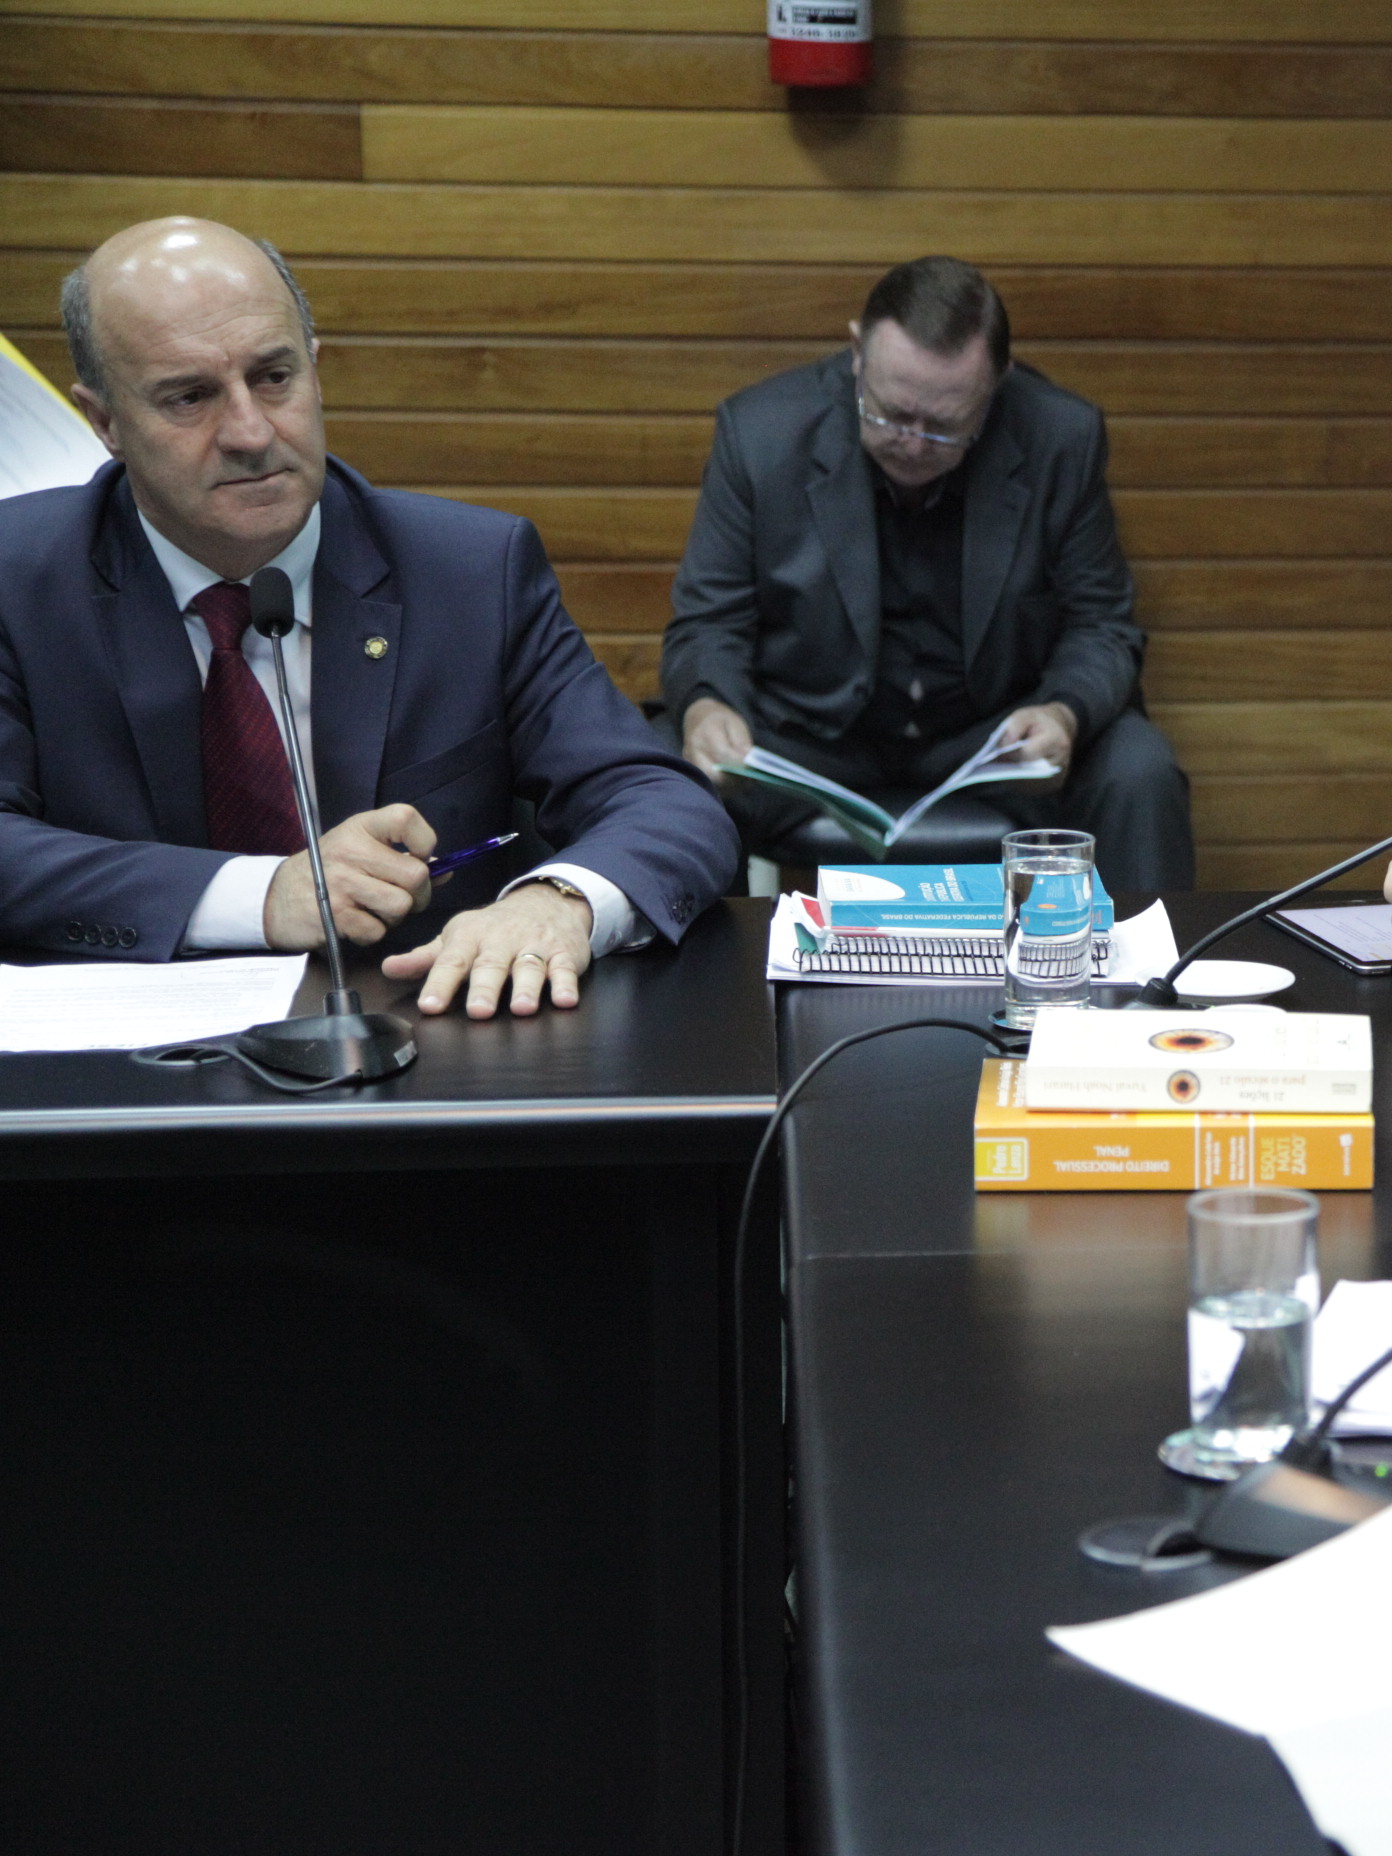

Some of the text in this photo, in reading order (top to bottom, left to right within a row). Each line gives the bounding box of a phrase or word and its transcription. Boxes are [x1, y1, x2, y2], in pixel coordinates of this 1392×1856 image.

[943, 867, 957, 881] BRASIL
[1043, 1080, 1148, 1093] Yuval Noah Harari
[1219, 1075, 1231, 1086] 21
[1233, 1075, 1270, 1086] século
[1281, 1075, 1306, 1086] para
[1239, 1090, 1285, 1102] 21 lições
[1092, 1145, 1131, 1158] PENAL
[1277, 1137, 1291, 1172] MATI
[1291, 1136, 1307, 1176] ZADO
[992, 1144, 1008, 1174] Pedro
[1008, 1144, 1022, 1174] Lenza
[1260, 1137, 1276, 1181] ESQUE
[1052, 1160, 1170, 1173] DIREITO PROCESSUAL
